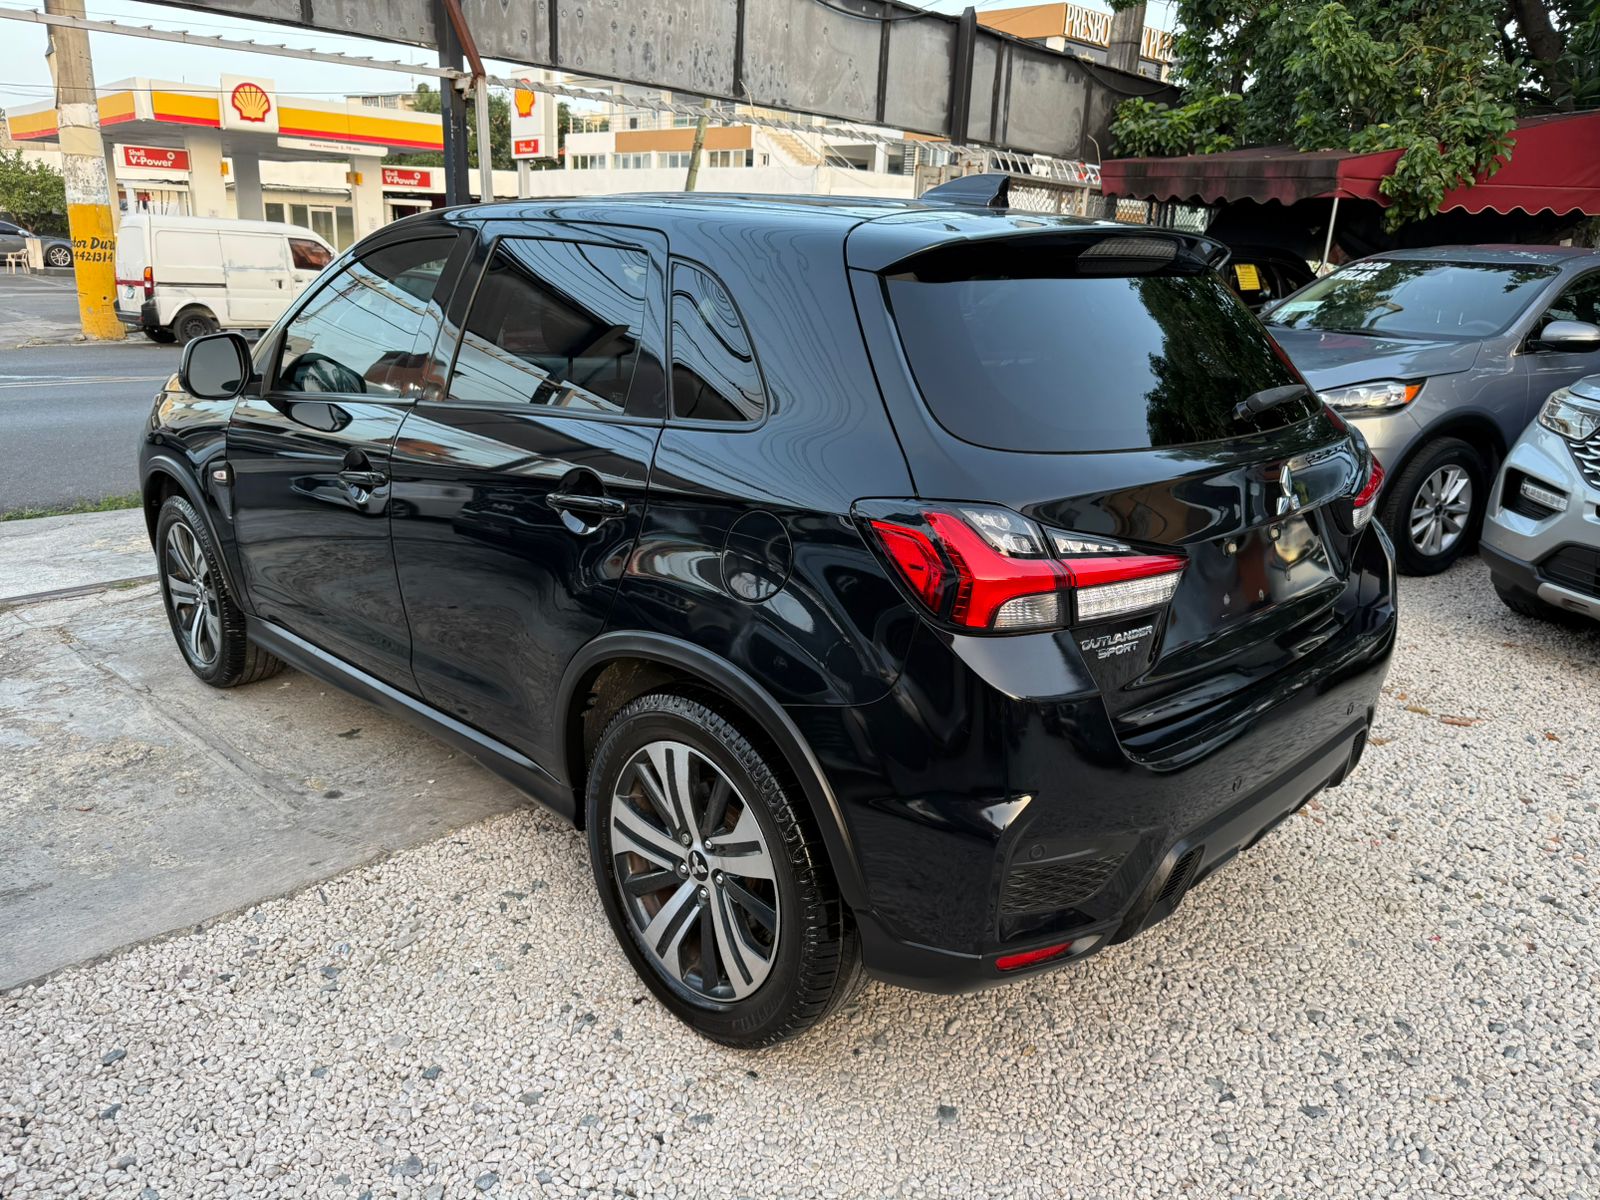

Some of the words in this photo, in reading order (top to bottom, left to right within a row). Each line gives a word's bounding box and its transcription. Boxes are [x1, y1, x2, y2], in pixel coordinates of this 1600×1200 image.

[129, 155, 173, 167] V-Power
[385, 175, 419, 185] V-Power
[1080, 625, 1153, 651] OUTLANDER
[1096, 641, 1139, 659] SPORT
